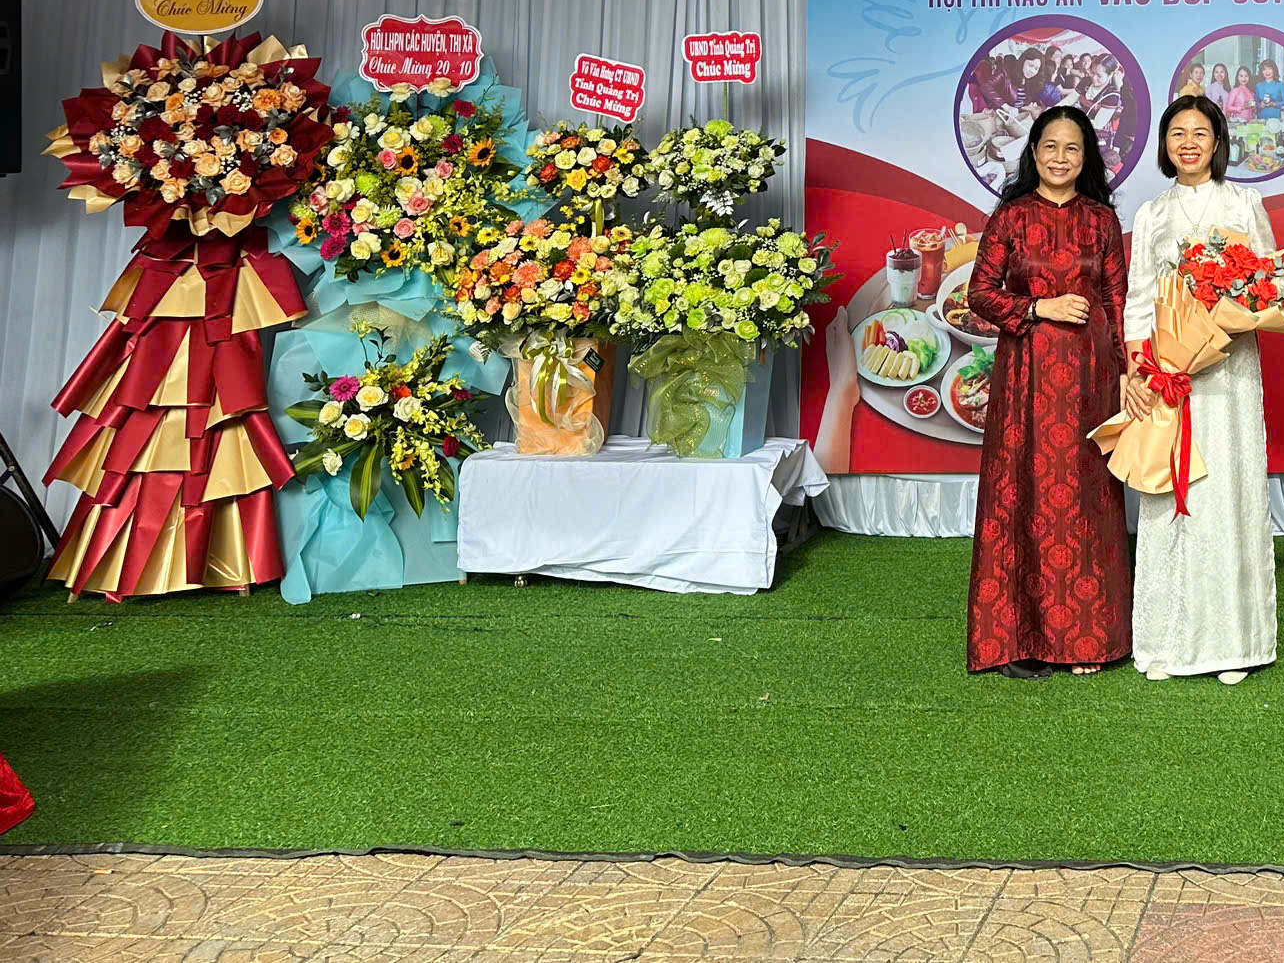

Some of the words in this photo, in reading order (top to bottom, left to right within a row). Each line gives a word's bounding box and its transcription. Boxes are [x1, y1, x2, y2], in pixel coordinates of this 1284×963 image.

[370, 28, 384, 54] HỘI
[384, 31, 405, 51] LHPN
[405, 28, 420, 52] CÁC
[449, 33, 462, 56] THỊ
[462, 31, 473, 53] XÃ
[689, 40, 709, 57] UBND
[709, 39, 724, 55] Tỉnh
[725, 39, 745, 58] Quảng
[745, 39, 756, 59] Trị
[368, 56, 397, 74] Chúc
[398, 57, 433, 78] Mừng
[435, 59, 451, 75] 20
[459, 60, 473, 76] 10
[614, 68, 624, 83] CT
[696, 59, 722, 77] Chúc
[723, 59, 752, 79] Mừng
[574, 77, 595, 92] Tỉnh
[596, 83, 625, 101] Quảng
[625, 88, 640, 104] Trị
[575, 92, 603, 108] Chúc
[603, 98, 633, 118] Mừng
